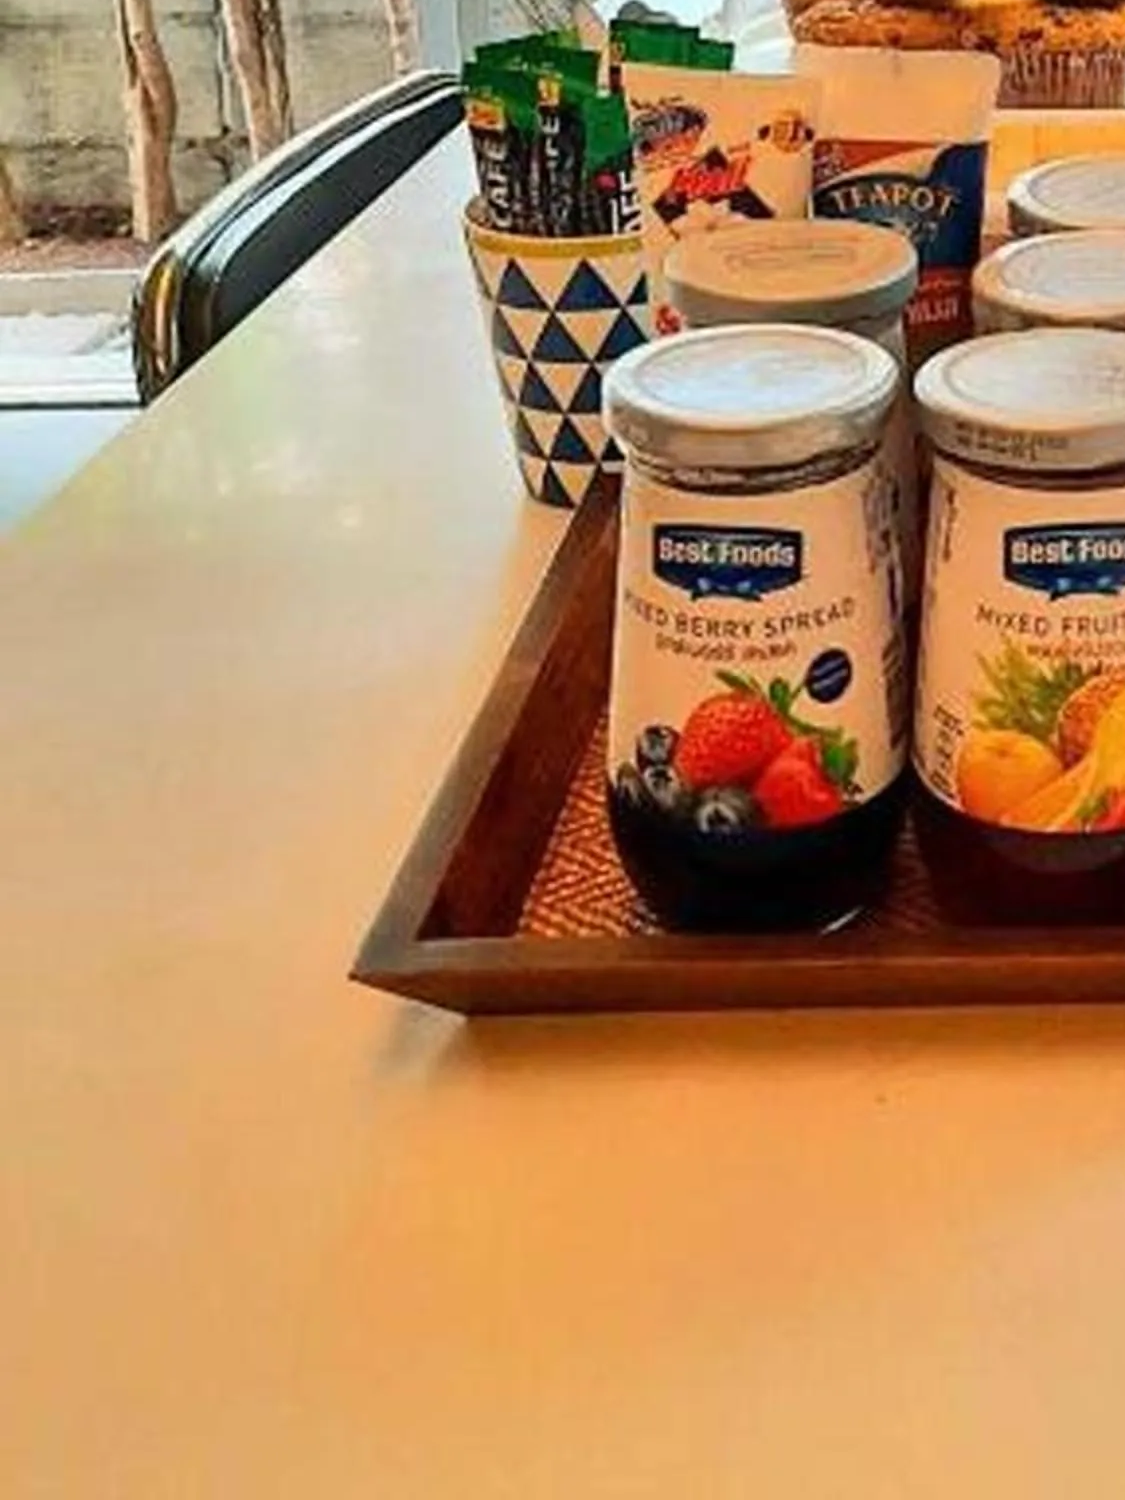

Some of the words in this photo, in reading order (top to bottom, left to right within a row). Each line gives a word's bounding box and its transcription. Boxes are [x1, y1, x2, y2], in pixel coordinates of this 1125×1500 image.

[831, 182, 962, 215] TEAPOT
[659, 537, 717, 563] Best
[719, 540, 796, 567] Foods
[1011, 538, 1075, 565] Best
[675, 611, 757, 639] BERRY
[765, 596, 856, 638] SPREAD
[976, 603, 1049, 637] MIXED
